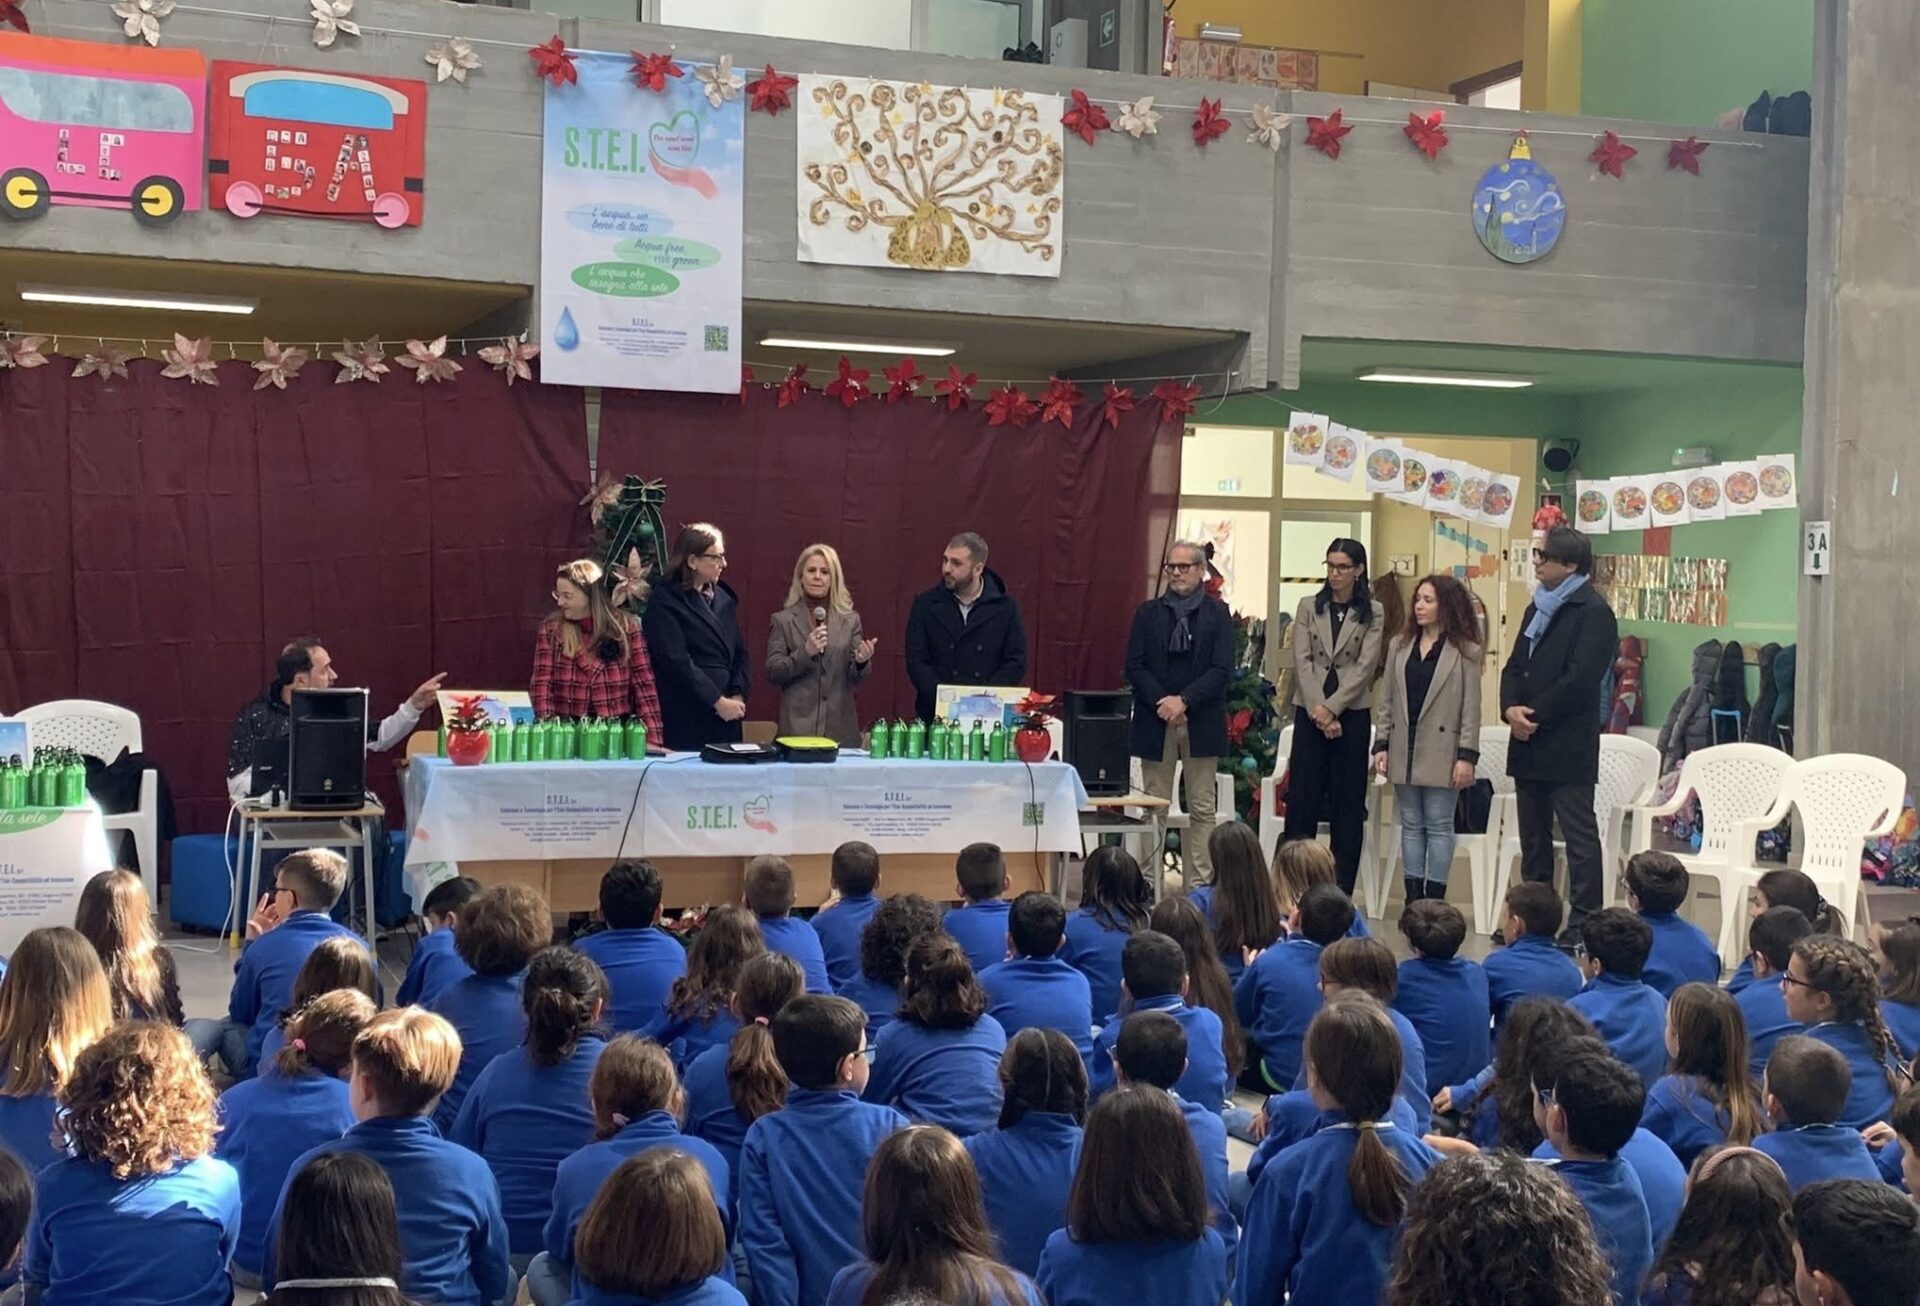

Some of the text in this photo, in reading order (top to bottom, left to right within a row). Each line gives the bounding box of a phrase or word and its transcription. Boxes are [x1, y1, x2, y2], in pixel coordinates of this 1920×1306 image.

[564, 126, 645, 173] S.T.E.I.
[592, 219, 614, 230] bene
[616, 220, 626, 231] di
[634, 238, 663, 252] Acqua
[629, 268, 646, 279] che
[629, 280, 648, 291] alla
[18, 811, 46, 824] sete
[687, 806, 737, 829] S.T.E.I.
